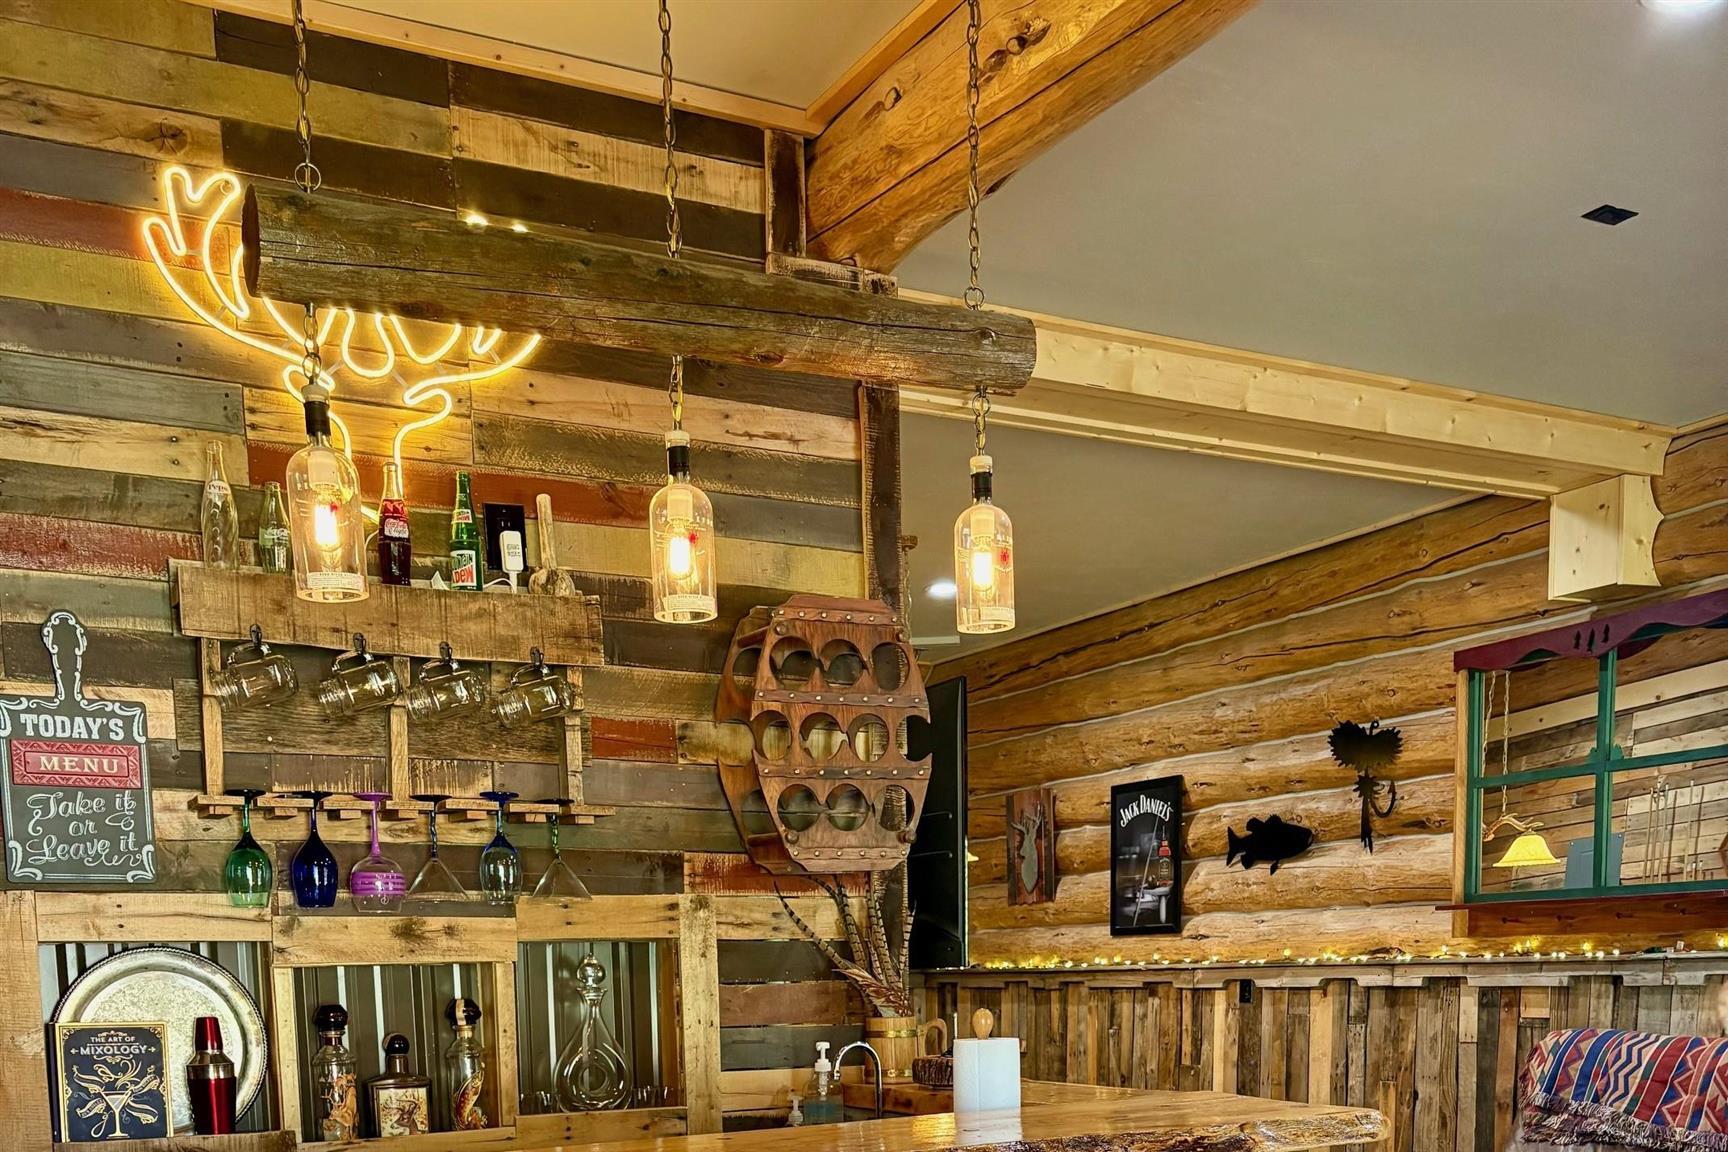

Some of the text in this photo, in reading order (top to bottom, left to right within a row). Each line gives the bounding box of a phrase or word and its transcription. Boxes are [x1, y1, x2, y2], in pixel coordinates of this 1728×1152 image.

[20, 713, 125, 741] TODAY'S
[39, 756, 120, 774] MENU
[26, 790, 137, 820] Take it
[1120, 800, 1140, 827] JACK
[69, 820, 98, 837] or
[26, 832, 139, 864] Leave it
[80, 1044, 148, 1056] MIXOLOGY
